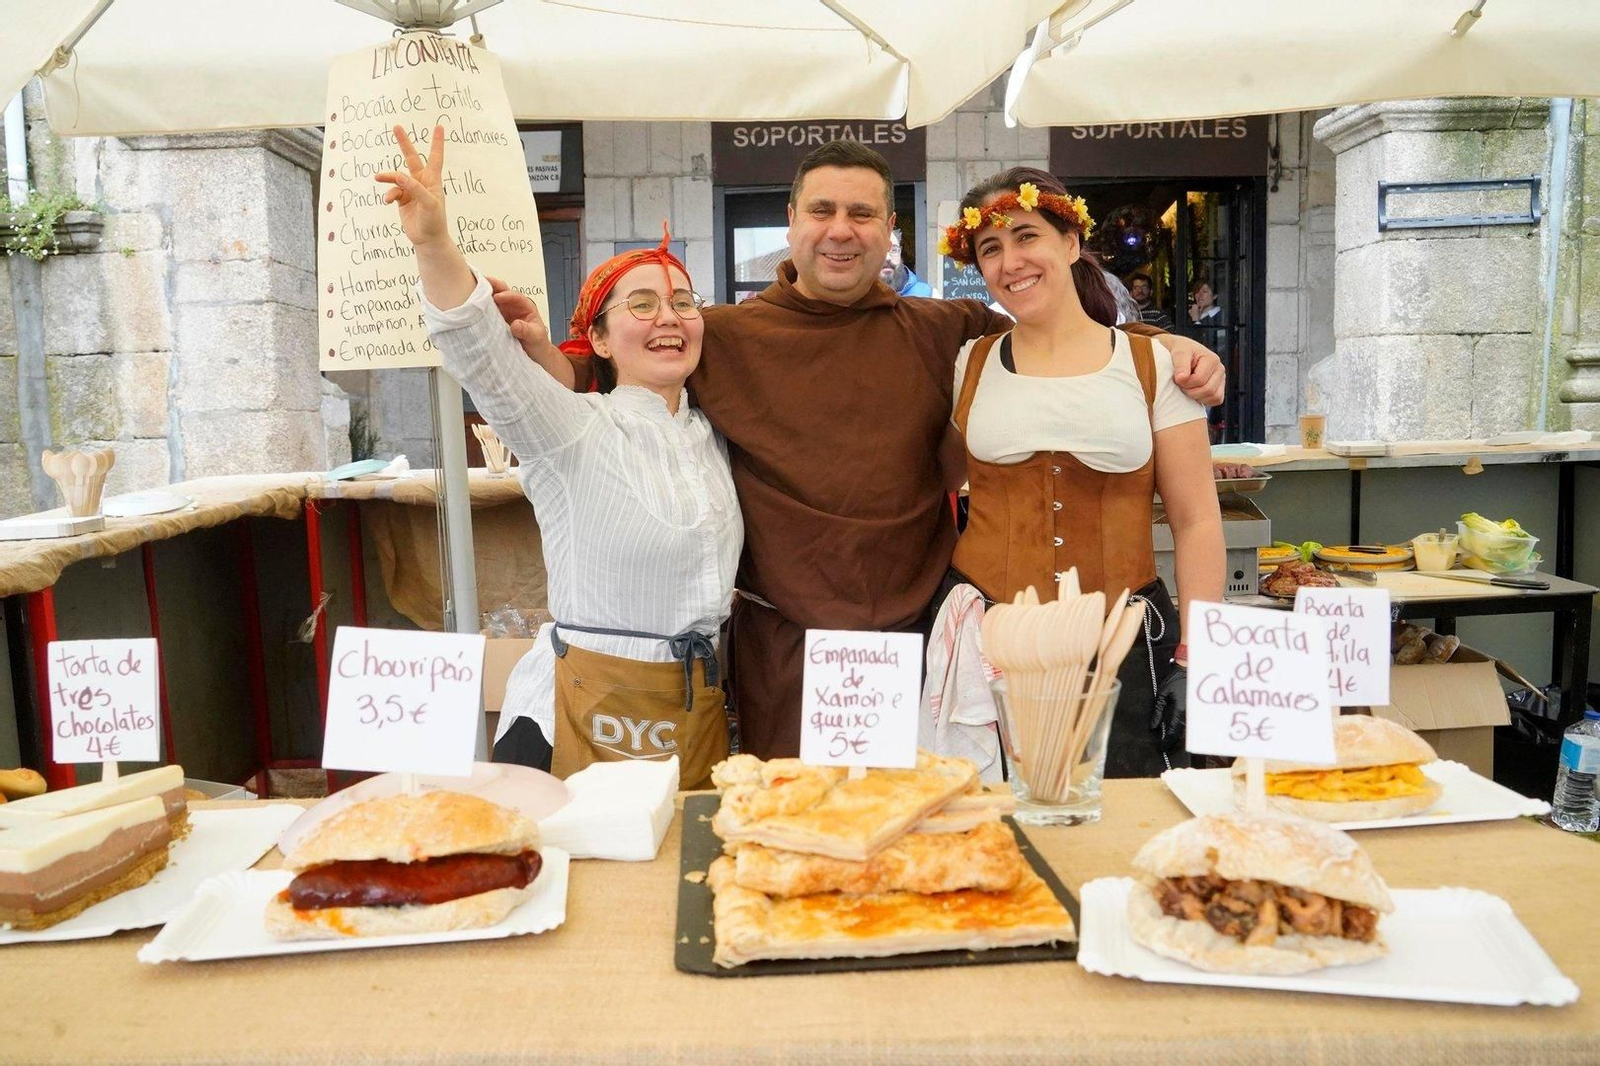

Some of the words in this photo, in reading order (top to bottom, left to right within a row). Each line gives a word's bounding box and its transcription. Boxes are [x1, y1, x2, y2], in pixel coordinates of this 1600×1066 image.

[341, 95, 396, 123] Bocata
[401, 88, 426, 112] de
[733, 124, 907, 147] SOPORTALES
[1072, 118, 1247, 140] SOPORTALES
[340, 339, 416, 361] Empanada
[1304, 595, 1365, 618] Bocata
[1204, 608, 1309, 655] Bocata
[1326, 621, 1351, 641] de
[117, 648, 142, 676] de
[809, 637, 899, 672] Empanada
[1234, 652, 1274, 683] de
[842, 667, 864, 689] de
[53, 682, 112, 711] tres
[1196, 673, 1319, 712] Calamares
[592, 714, 678, 750] DYC
[1228, 711, 1275, 742] 5€
[86, 736, 121, 758] 4€
[828, 731, 870, 758] 5€
